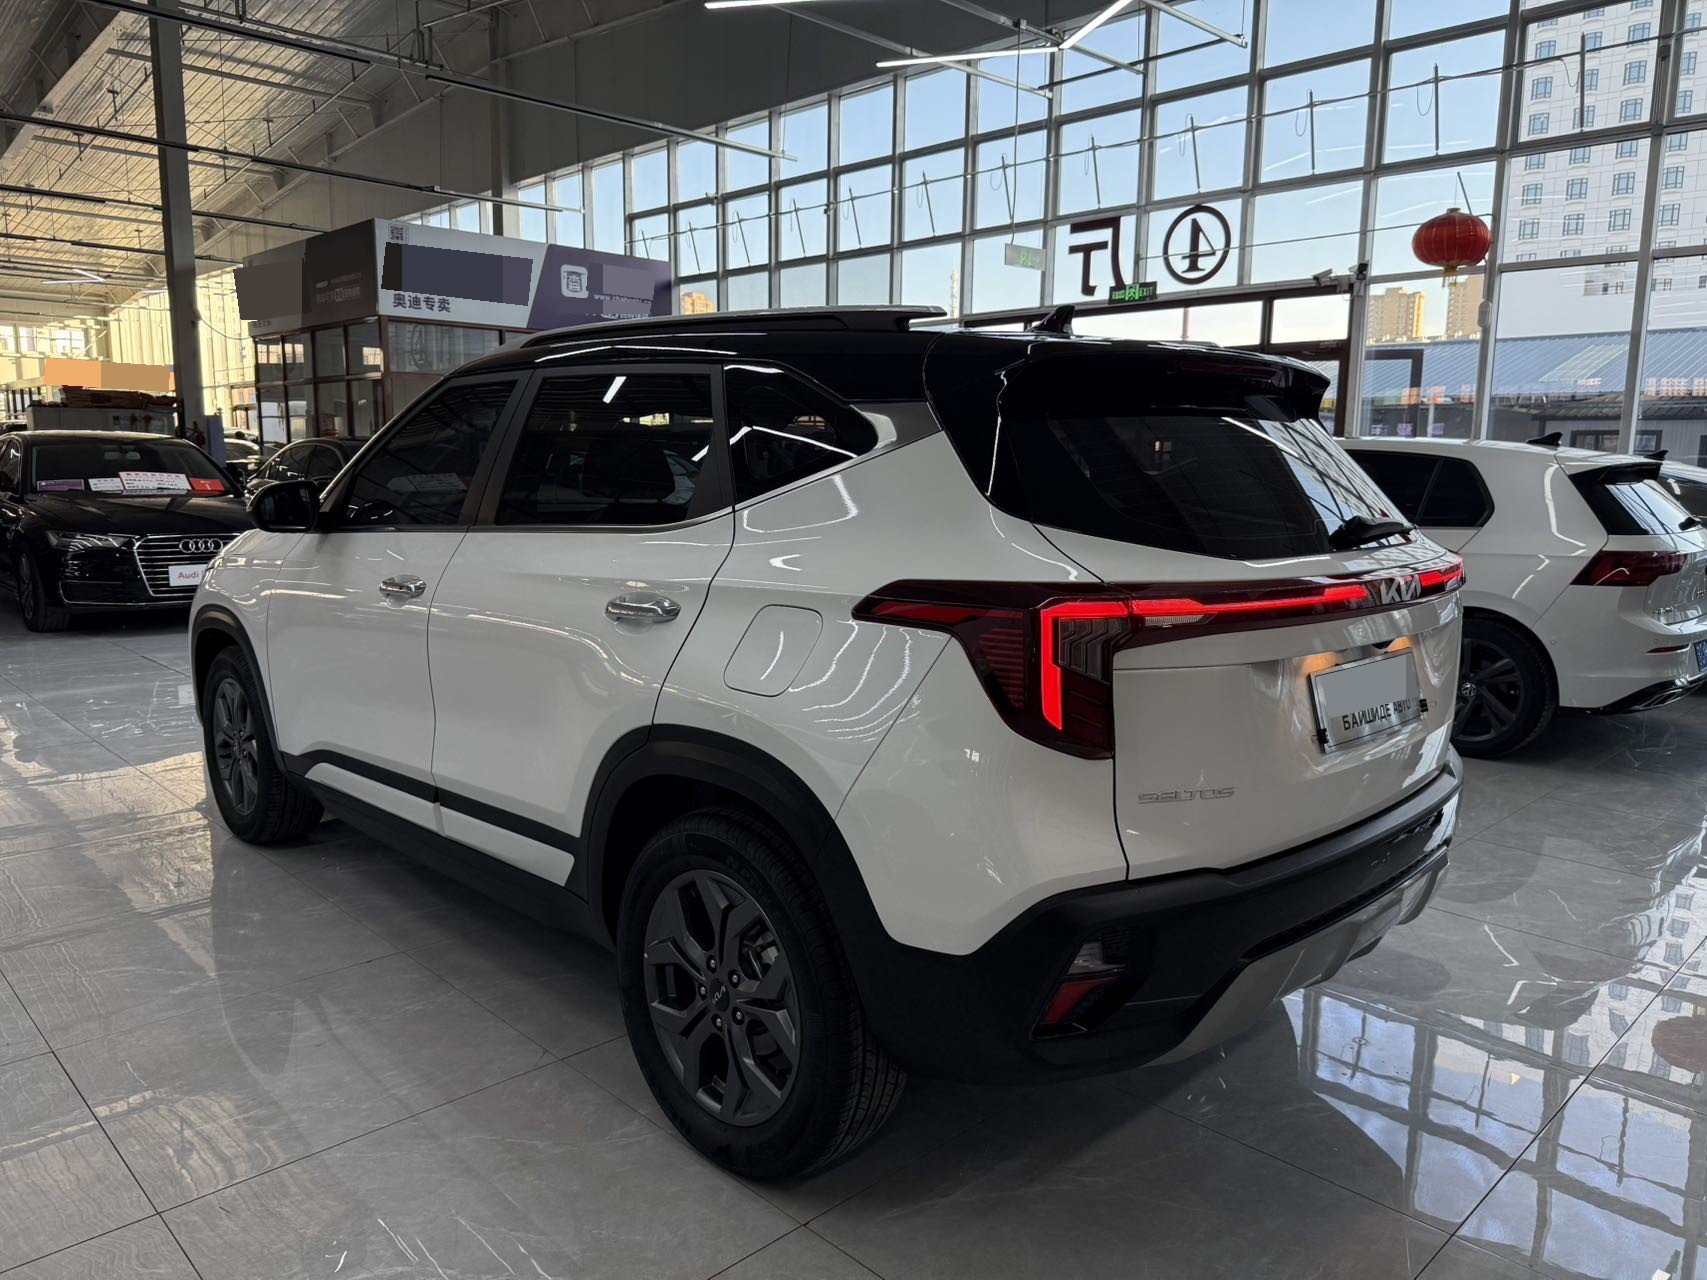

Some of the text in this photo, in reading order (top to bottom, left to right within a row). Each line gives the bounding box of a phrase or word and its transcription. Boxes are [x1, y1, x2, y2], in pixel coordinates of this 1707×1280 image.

[393, 293, 451, 313] 奥迪专卖
[178, 571, 200, 580] Audi
